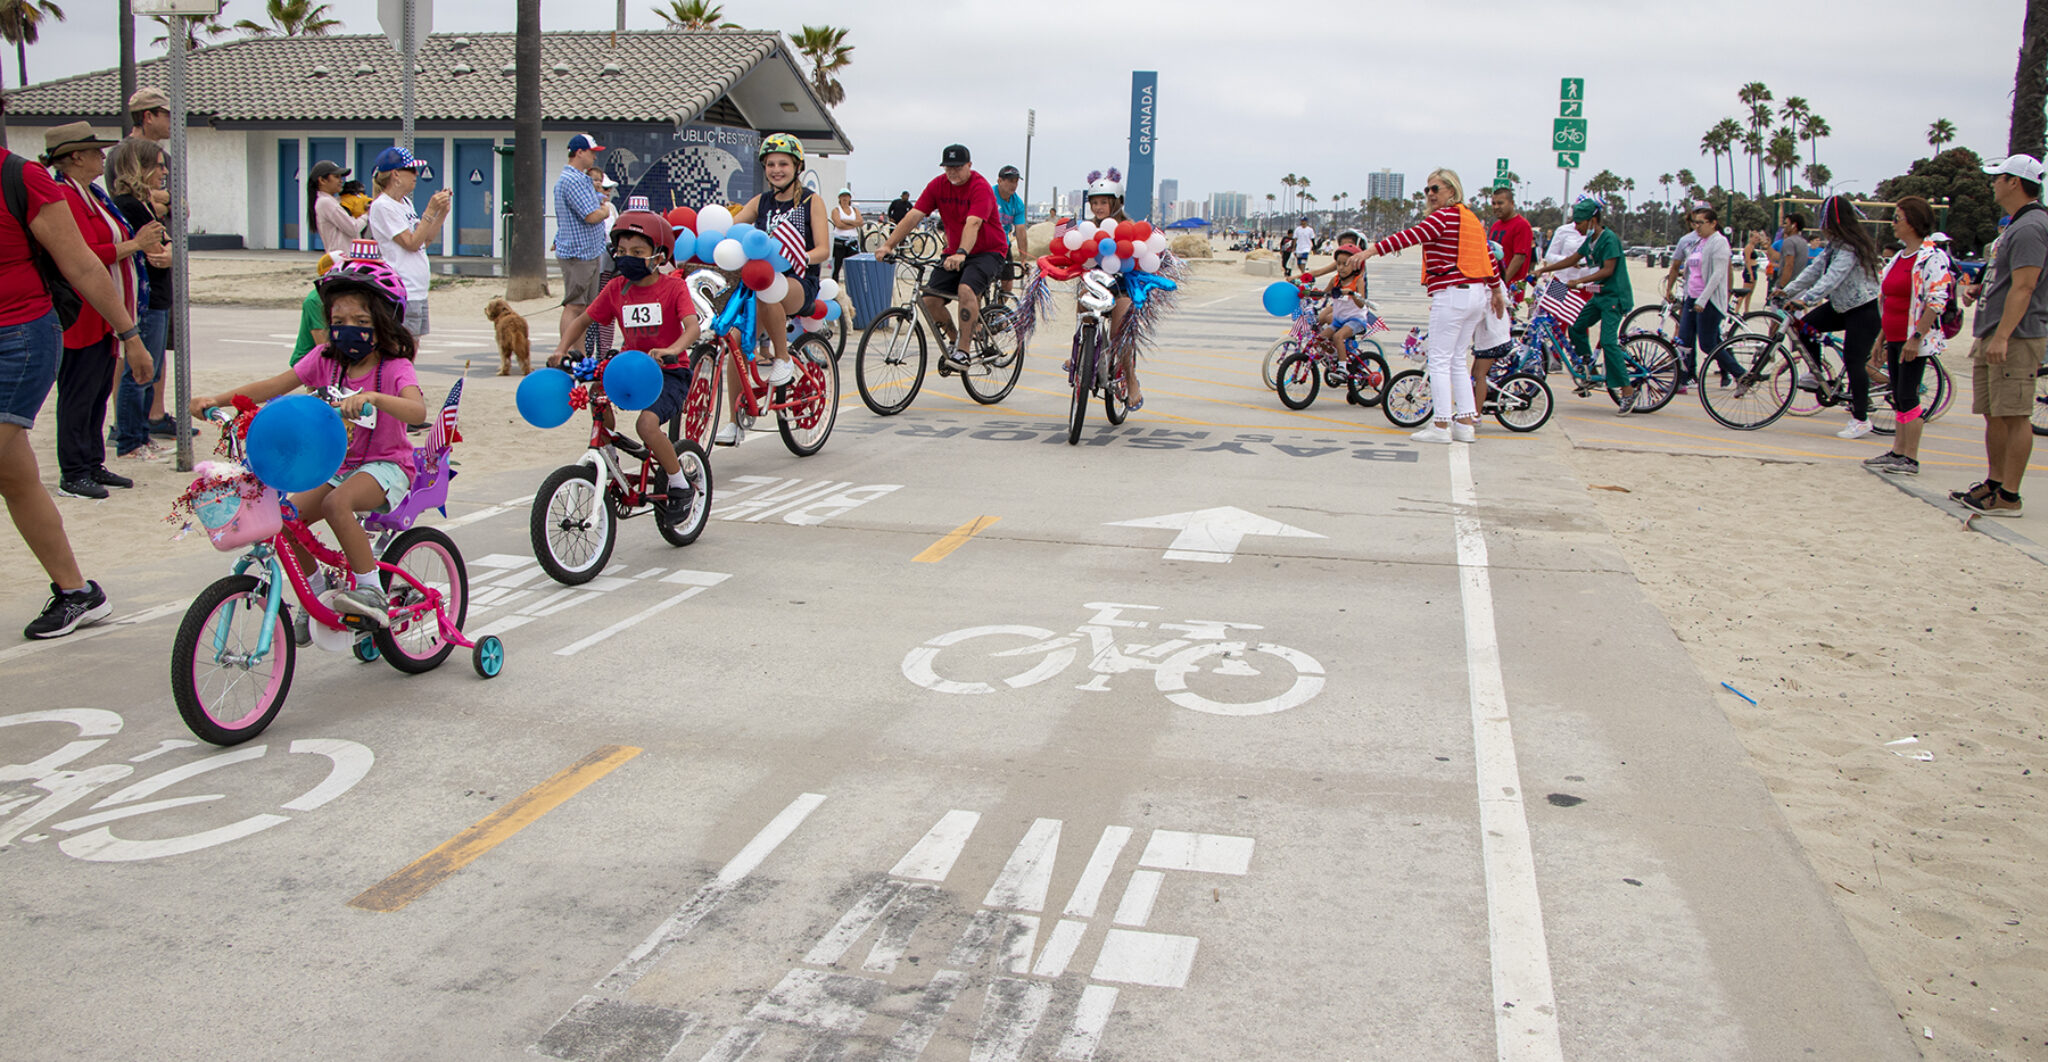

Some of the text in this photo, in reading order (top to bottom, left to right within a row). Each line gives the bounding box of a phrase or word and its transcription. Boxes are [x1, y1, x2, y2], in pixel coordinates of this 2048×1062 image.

[1139, 85, 1153, 155] GRANADA
[673, 130, 715, 143] PUBLIC
[631, 306, 651, 323] 43
[833, 421, 1420, 463] BAYSHORE
[977, 420, 1211, 440] MILES
[527, 792, 1257, 1062] LANE
